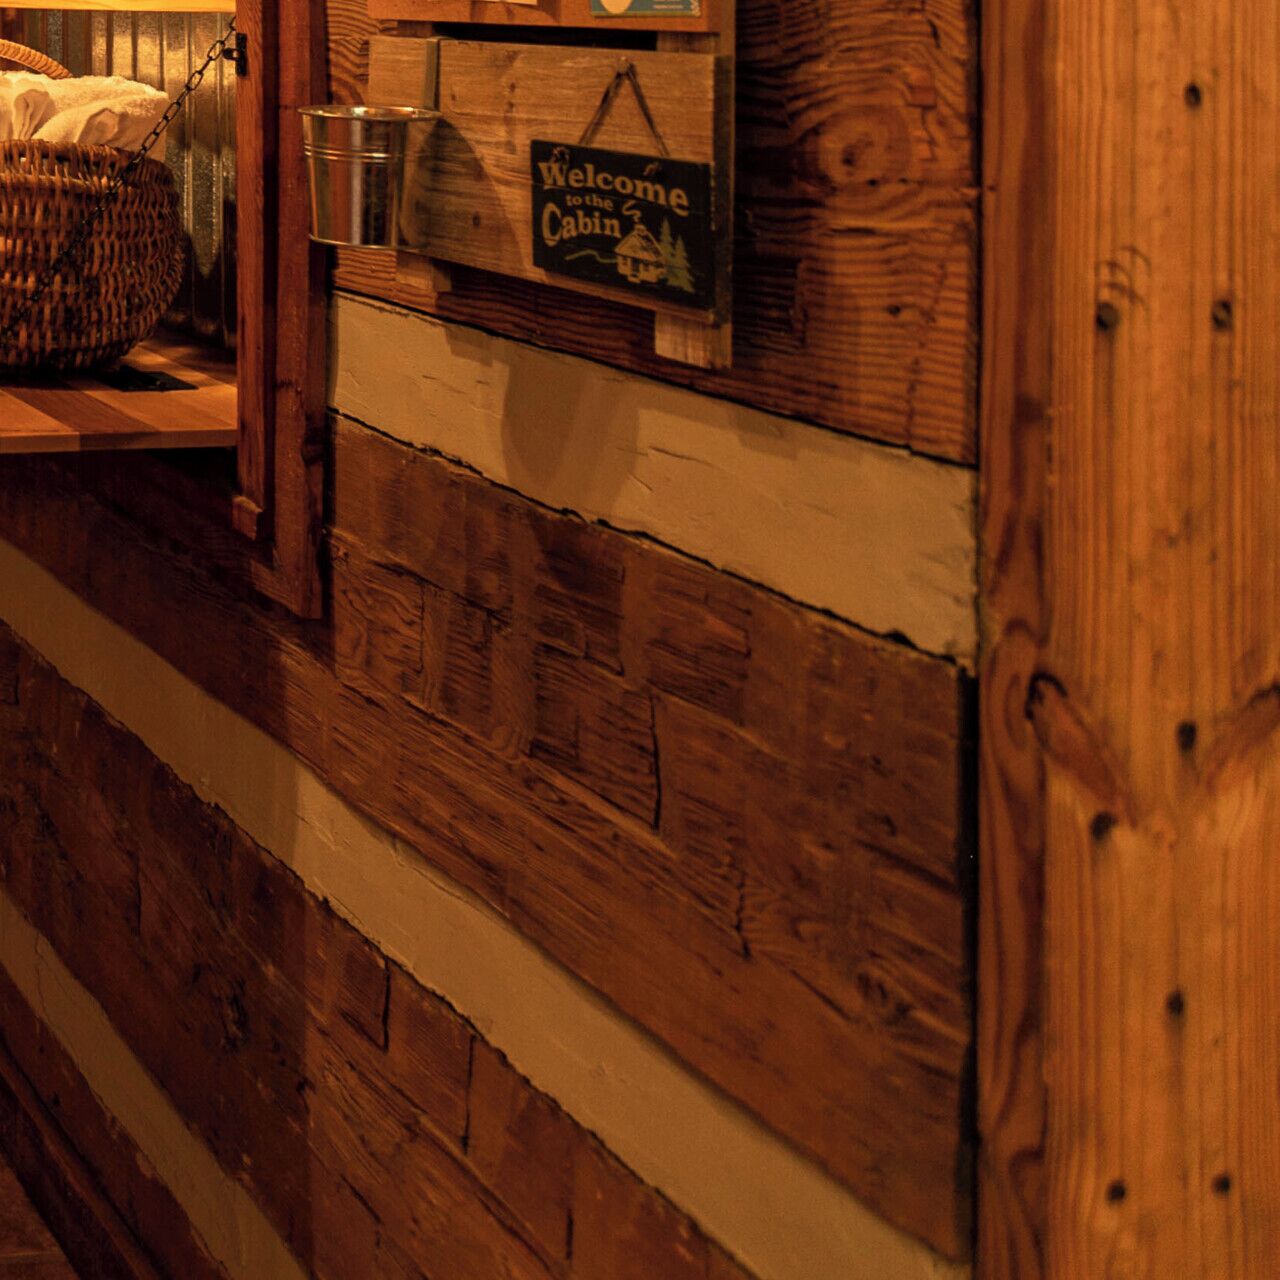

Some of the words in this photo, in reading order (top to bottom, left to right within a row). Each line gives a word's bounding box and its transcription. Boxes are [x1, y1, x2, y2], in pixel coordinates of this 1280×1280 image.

[538, 162, 690, 218] Welcome
[565, 194, 583, 207] to
[585, 194, 614, 212] the
[541, 202, 623, 247] Cabin
